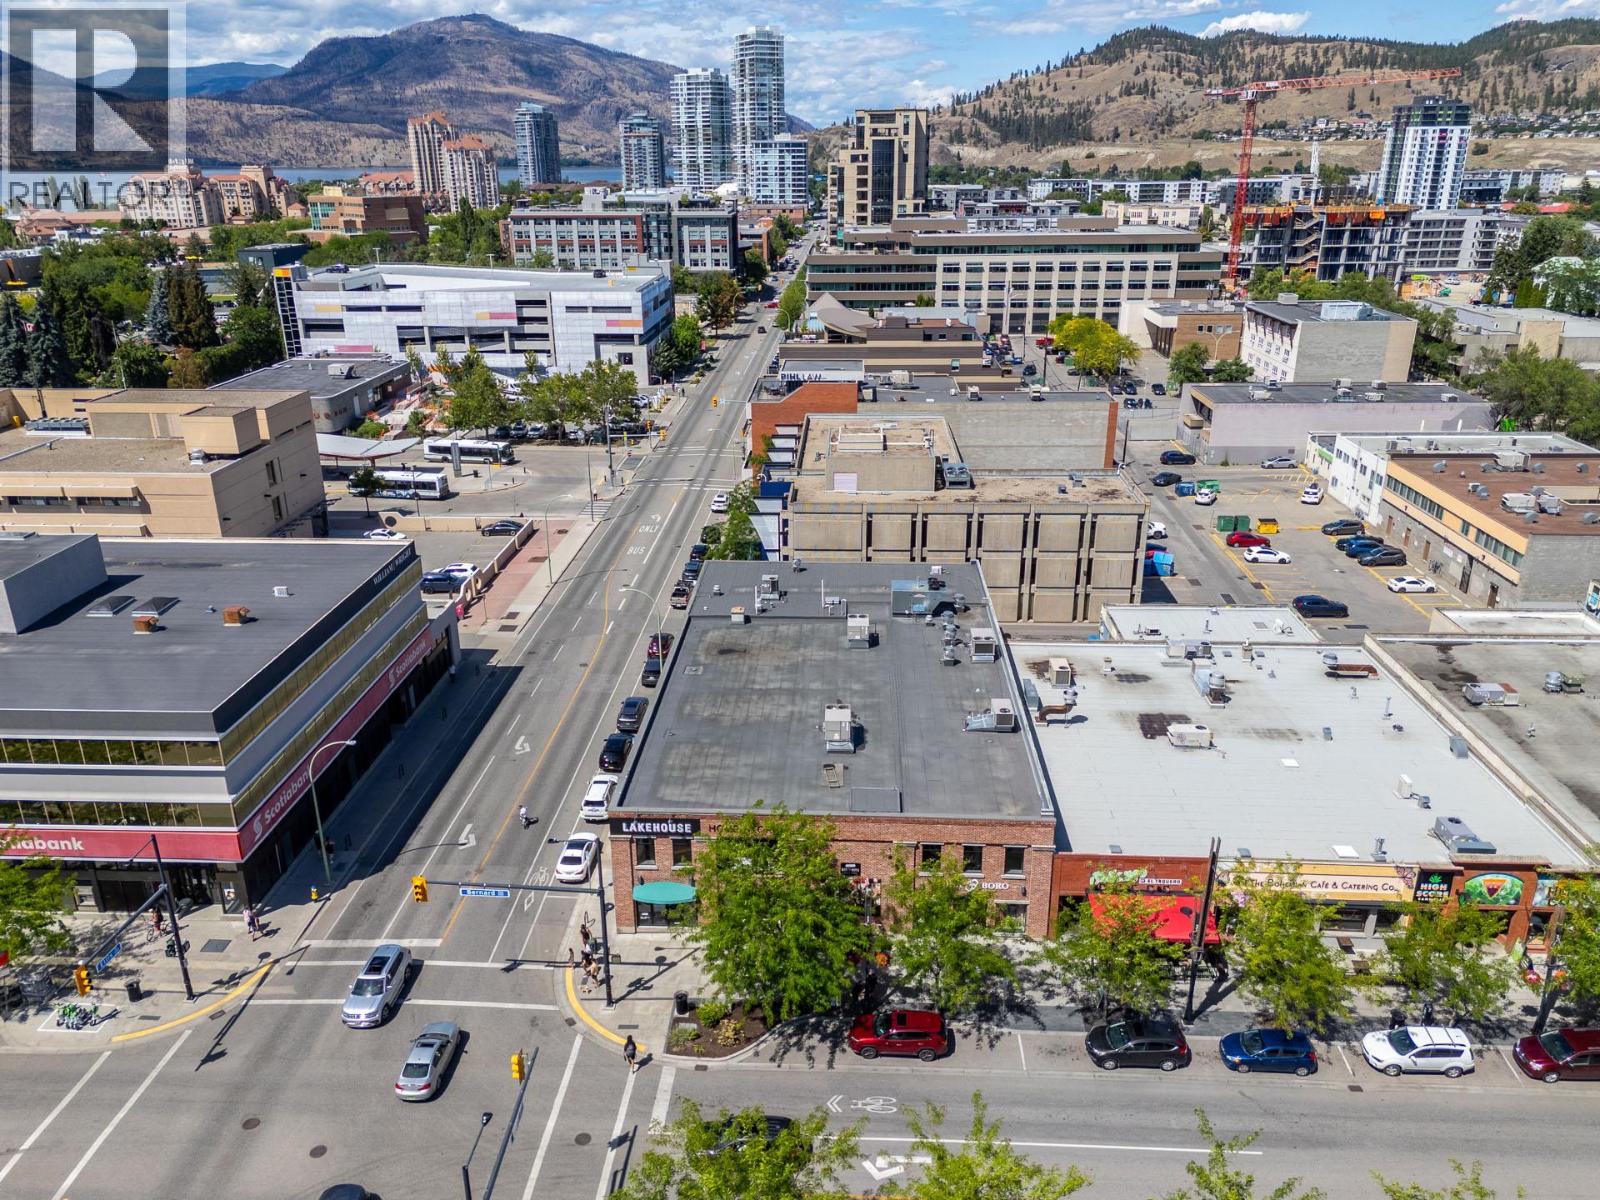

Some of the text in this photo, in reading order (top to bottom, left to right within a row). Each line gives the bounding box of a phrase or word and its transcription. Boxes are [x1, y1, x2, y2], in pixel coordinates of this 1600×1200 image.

[627, 546, 646, 555] BUS
[396, 640, 426, 678] Scotiabank
[264, 764, 310, 824] Scotiaban
[622, 822, 692, 833] LAKEHOUSE
[982, 882, 1009, 890] BORO
[1420, 883, 1448, 891] HIGH
[1416, 890, 1449, 898] SCORE
